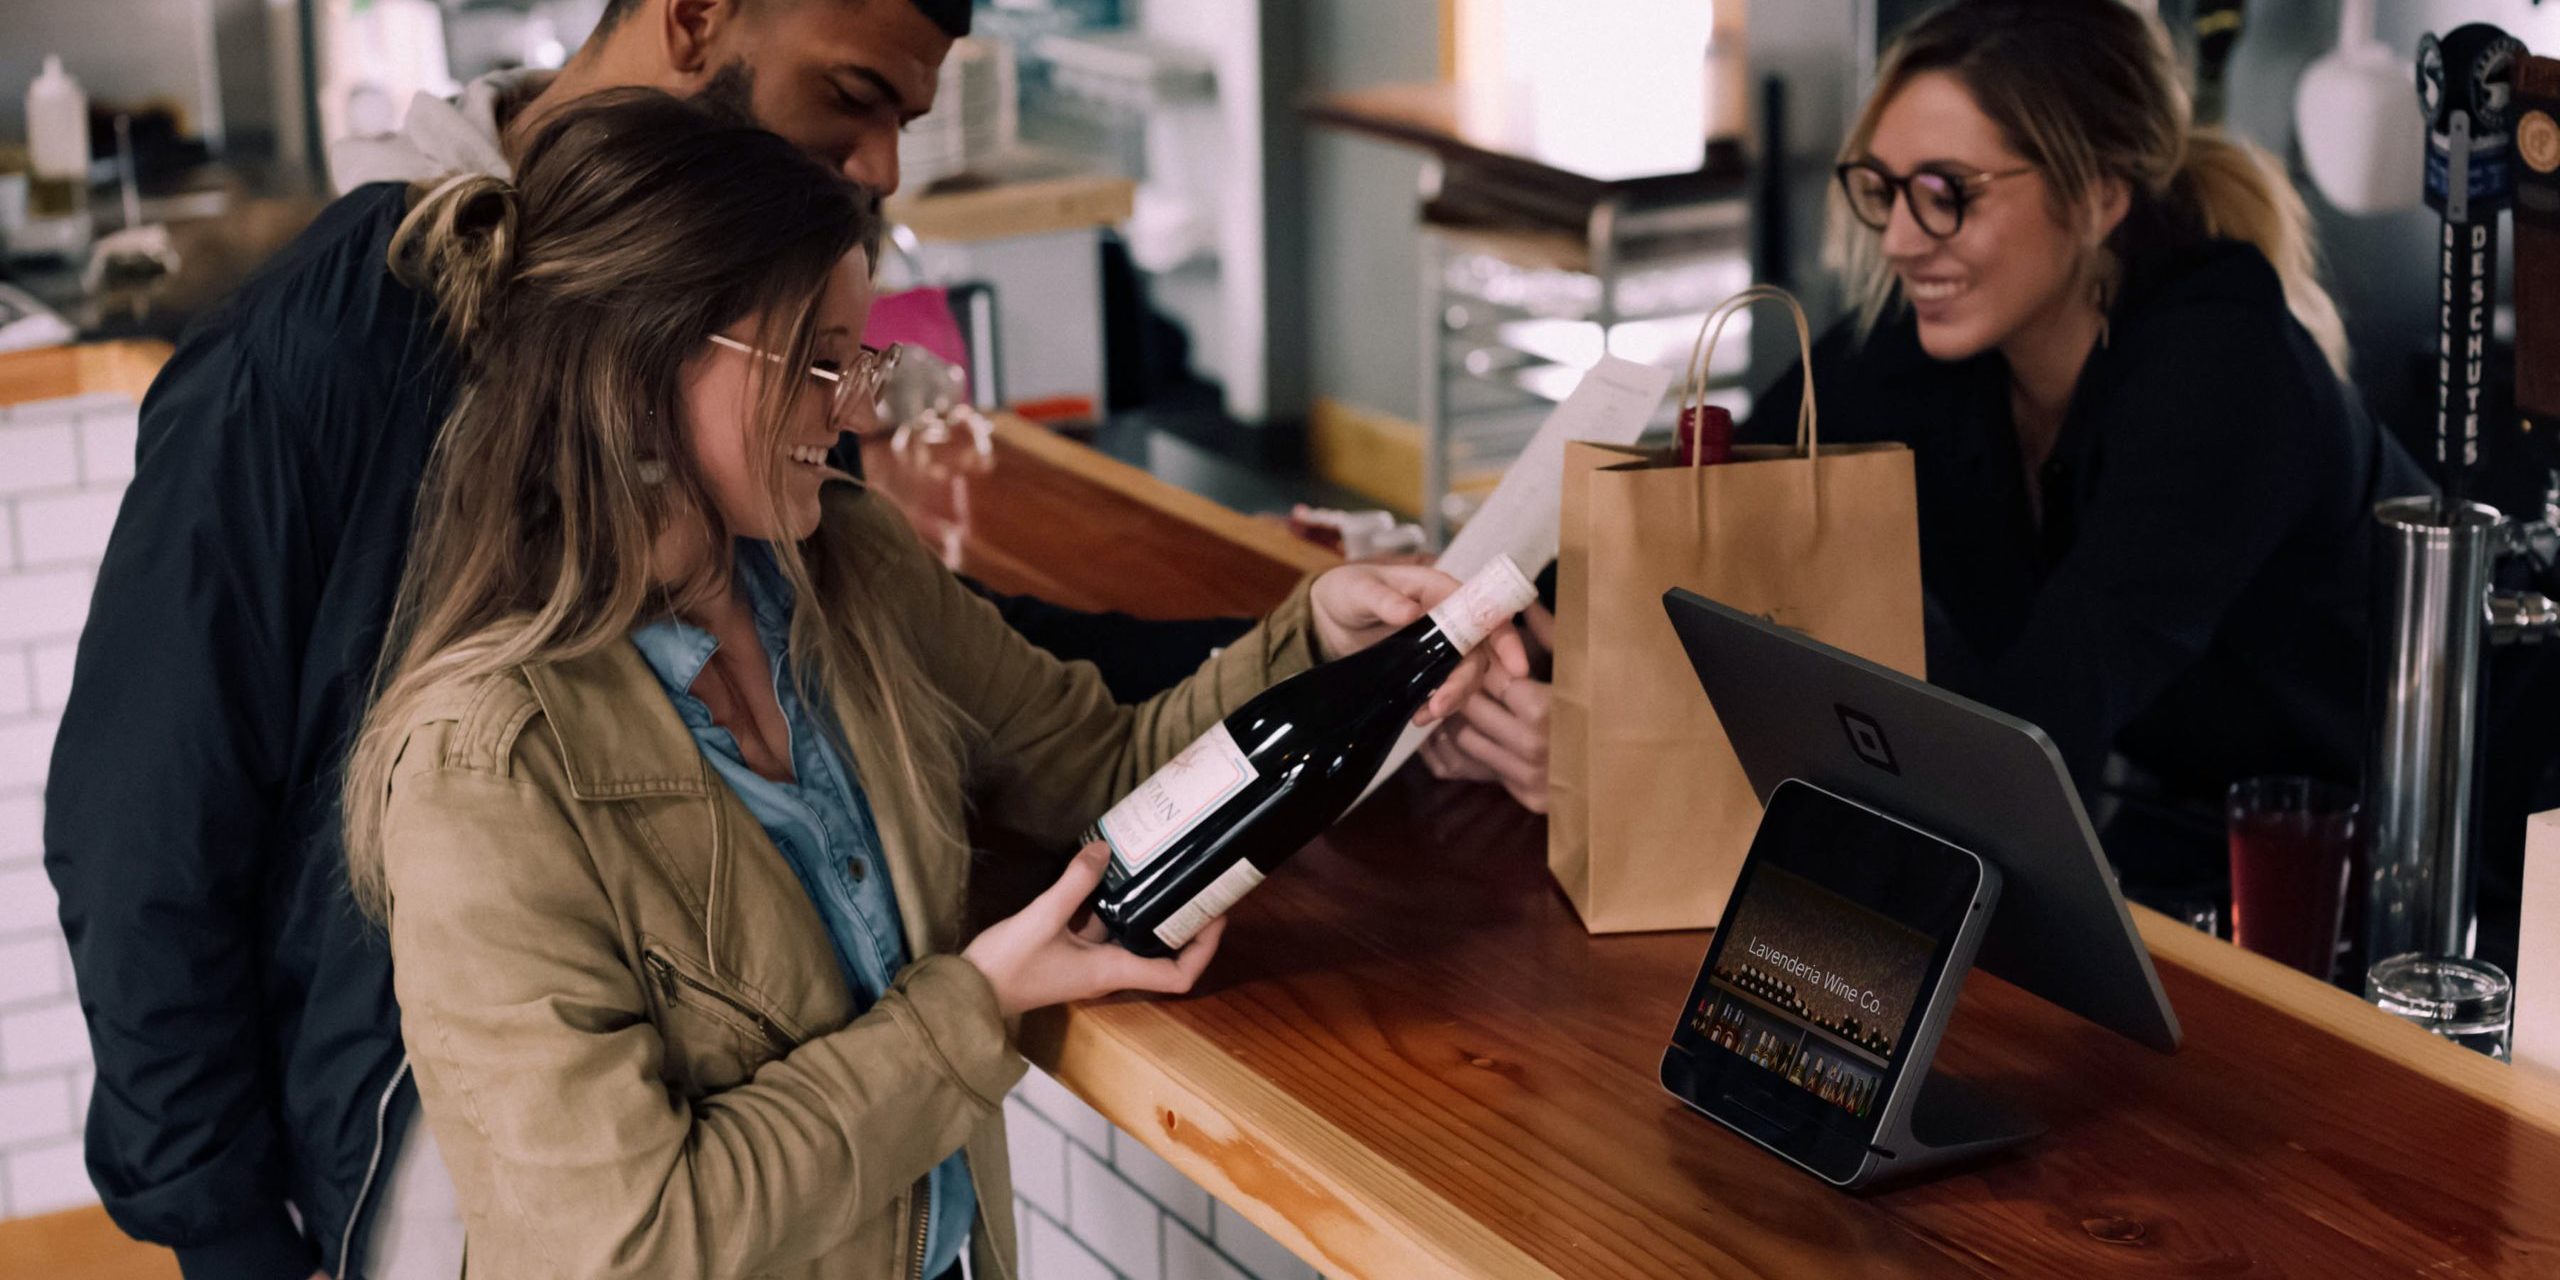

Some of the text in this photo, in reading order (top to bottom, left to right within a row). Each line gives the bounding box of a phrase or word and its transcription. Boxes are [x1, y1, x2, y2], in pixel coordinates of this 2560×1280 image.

[2463, 224, 2487, 466] DESCHUTES
[1147, 781, 1181, 821] TAIN
[1749, 936, 1881, 1015] Lavenderia Wine Co.
